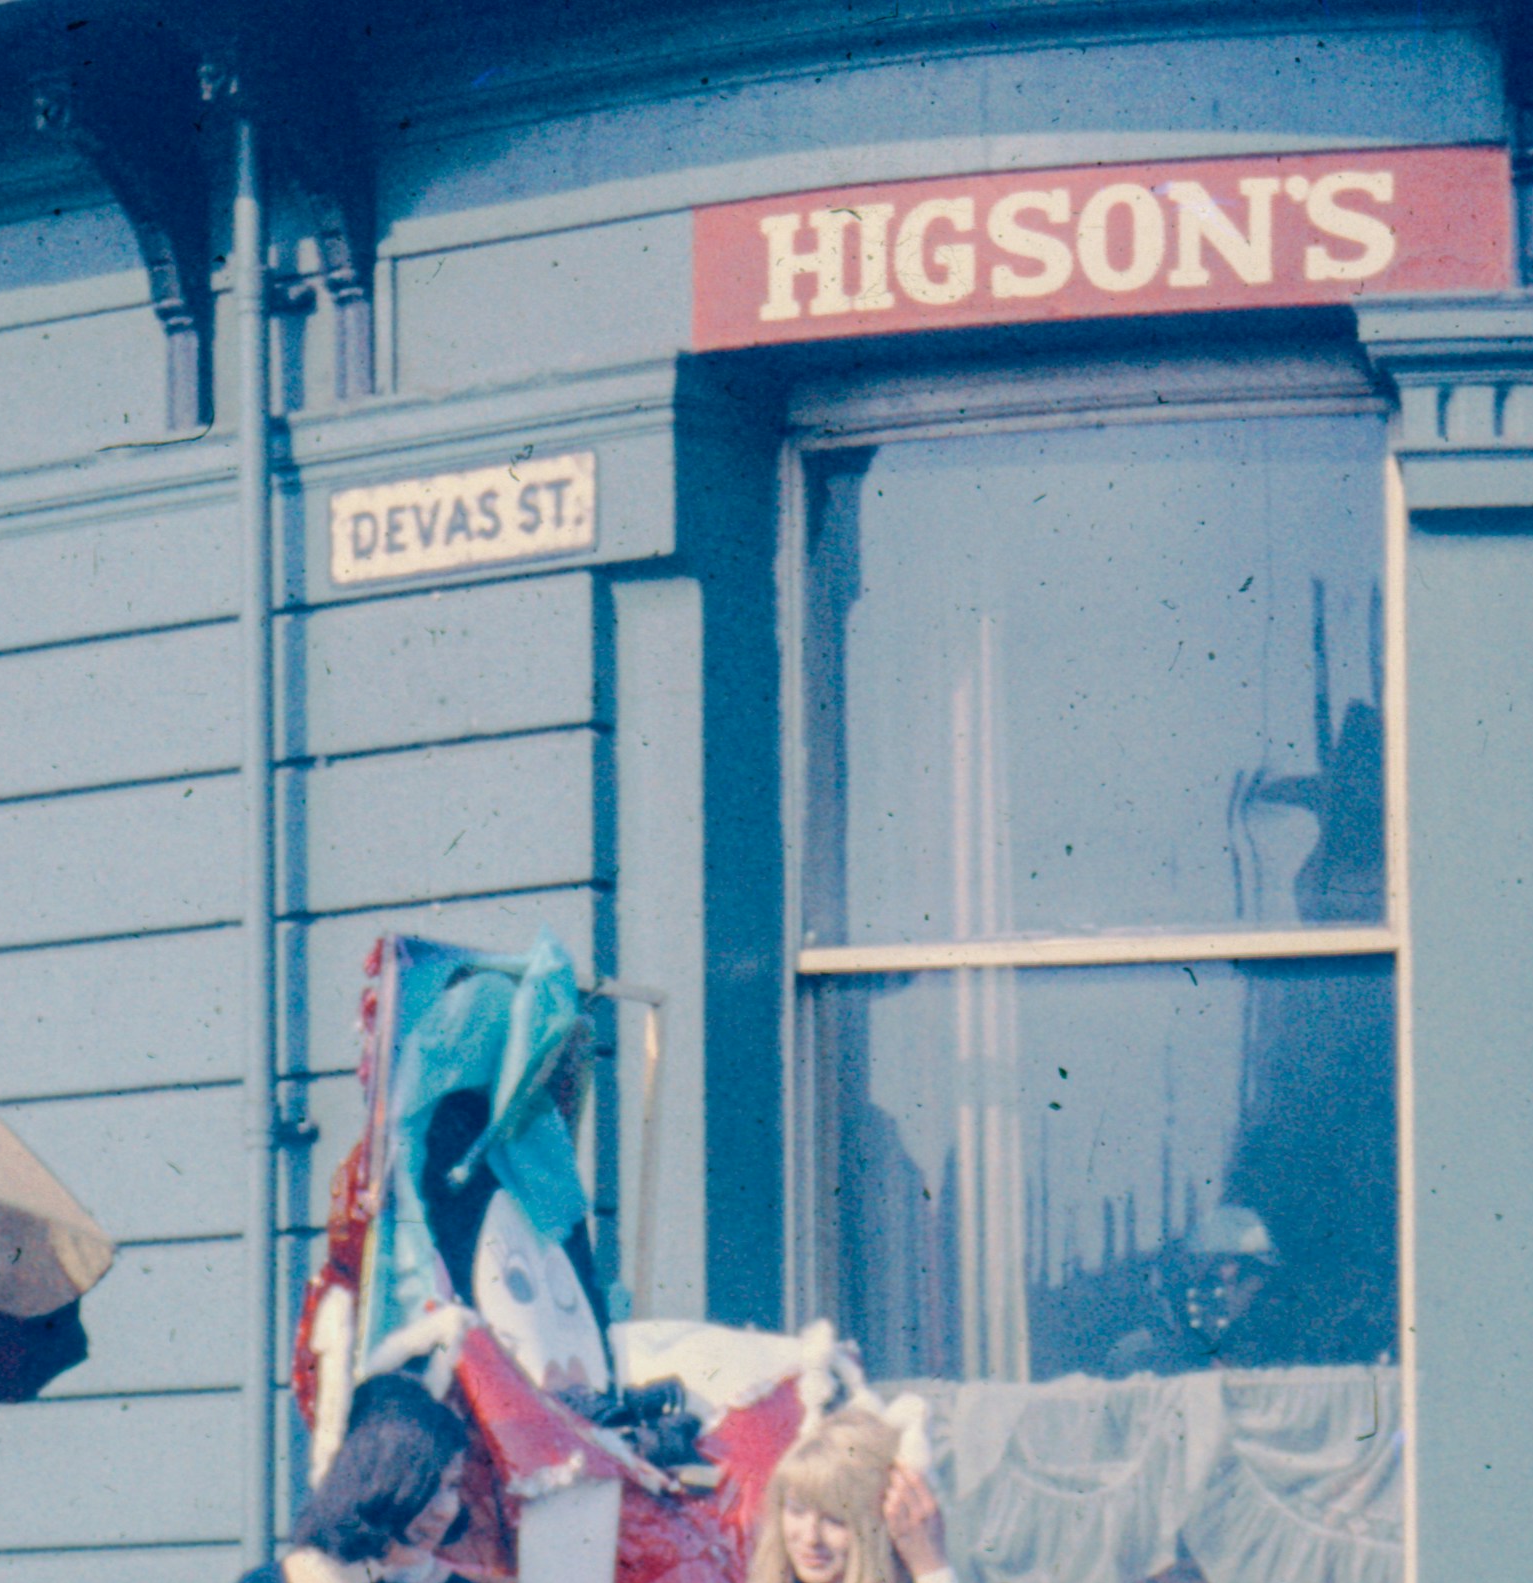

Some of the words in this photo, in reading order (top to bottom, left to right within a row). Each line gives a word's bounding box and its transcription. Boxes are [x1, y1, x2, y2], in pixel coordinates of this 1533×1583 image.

[759, 170, 1396, 321] HIGSON'S
[351, 487, 502, 560] DEVAS
[518, 477, 585, 535] ST.
